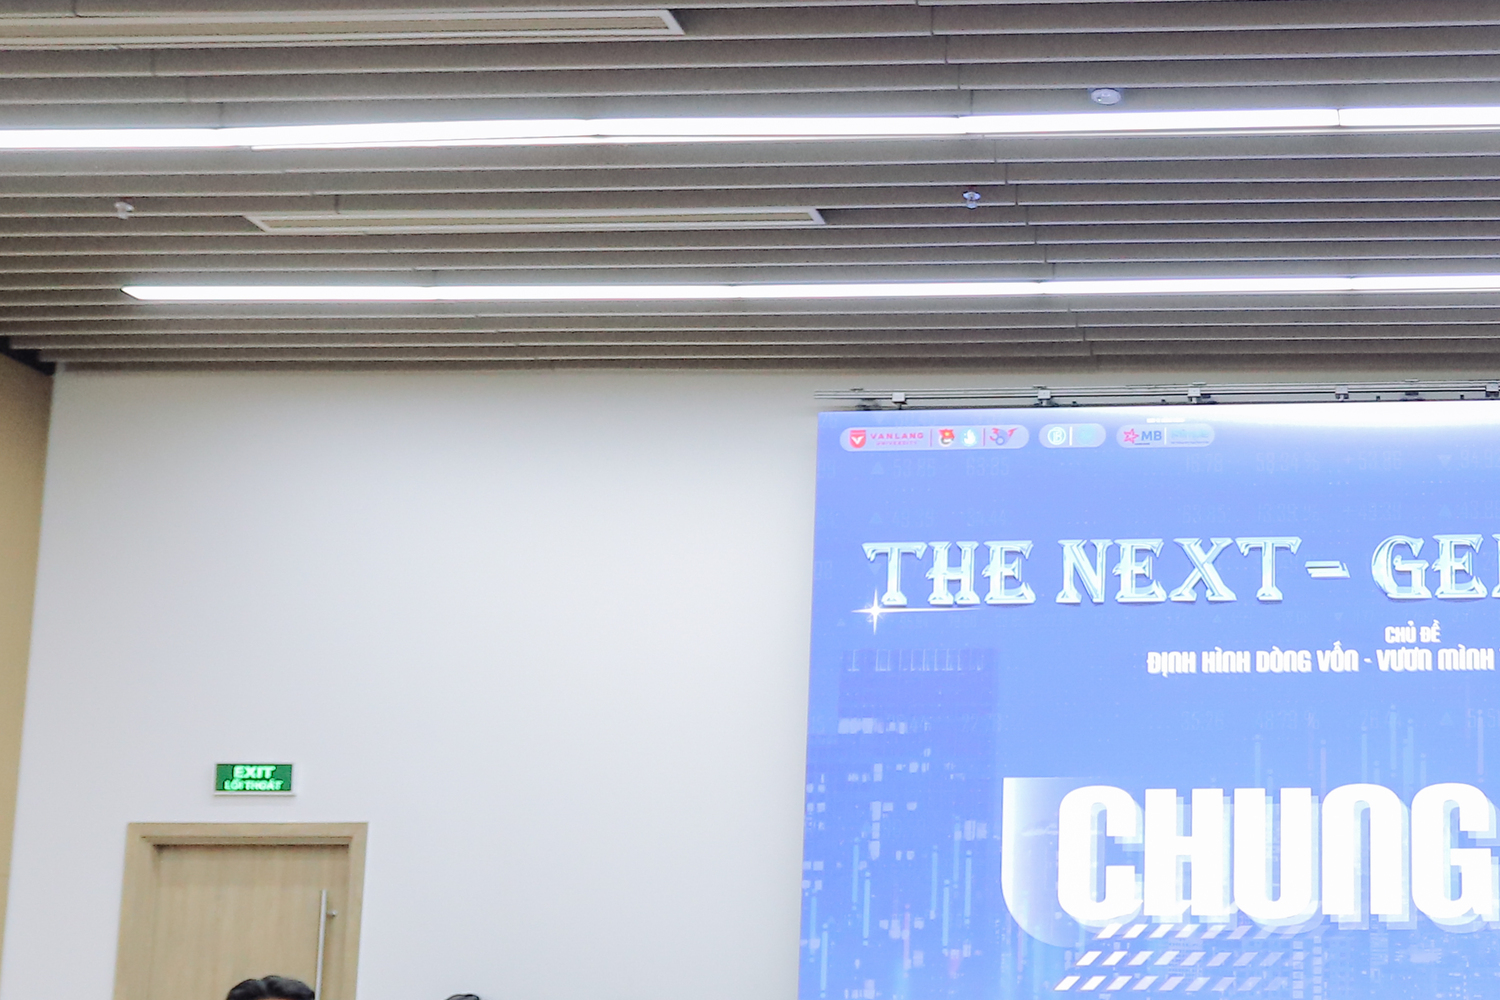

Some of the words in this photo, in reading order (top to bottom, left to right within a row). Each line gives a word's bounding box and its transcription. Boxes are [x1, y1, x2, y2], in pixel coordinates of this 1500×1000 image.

[1141, 430, 1163, 441] MB
[862, 540, 1036, 606] THE
[1384, 620, 1417, 643] CHỦ
[1420, 619, 1441, 643] ĐỀ
[1147, 651, 1197, 678] ĐỊNH
[1201, 646, 1251, 673] HÌNH
[1256, 645, 1312, 673] DÒNG
[1316, 640, 1359, 672] VỐN
[1376, 646, 1433, 672] VƯƠN
[1438, 644, 1496, 671] MÌNH
[233, 765, 277, 779] EXIT
[1057, 783, 1500, 924] CHUNG
